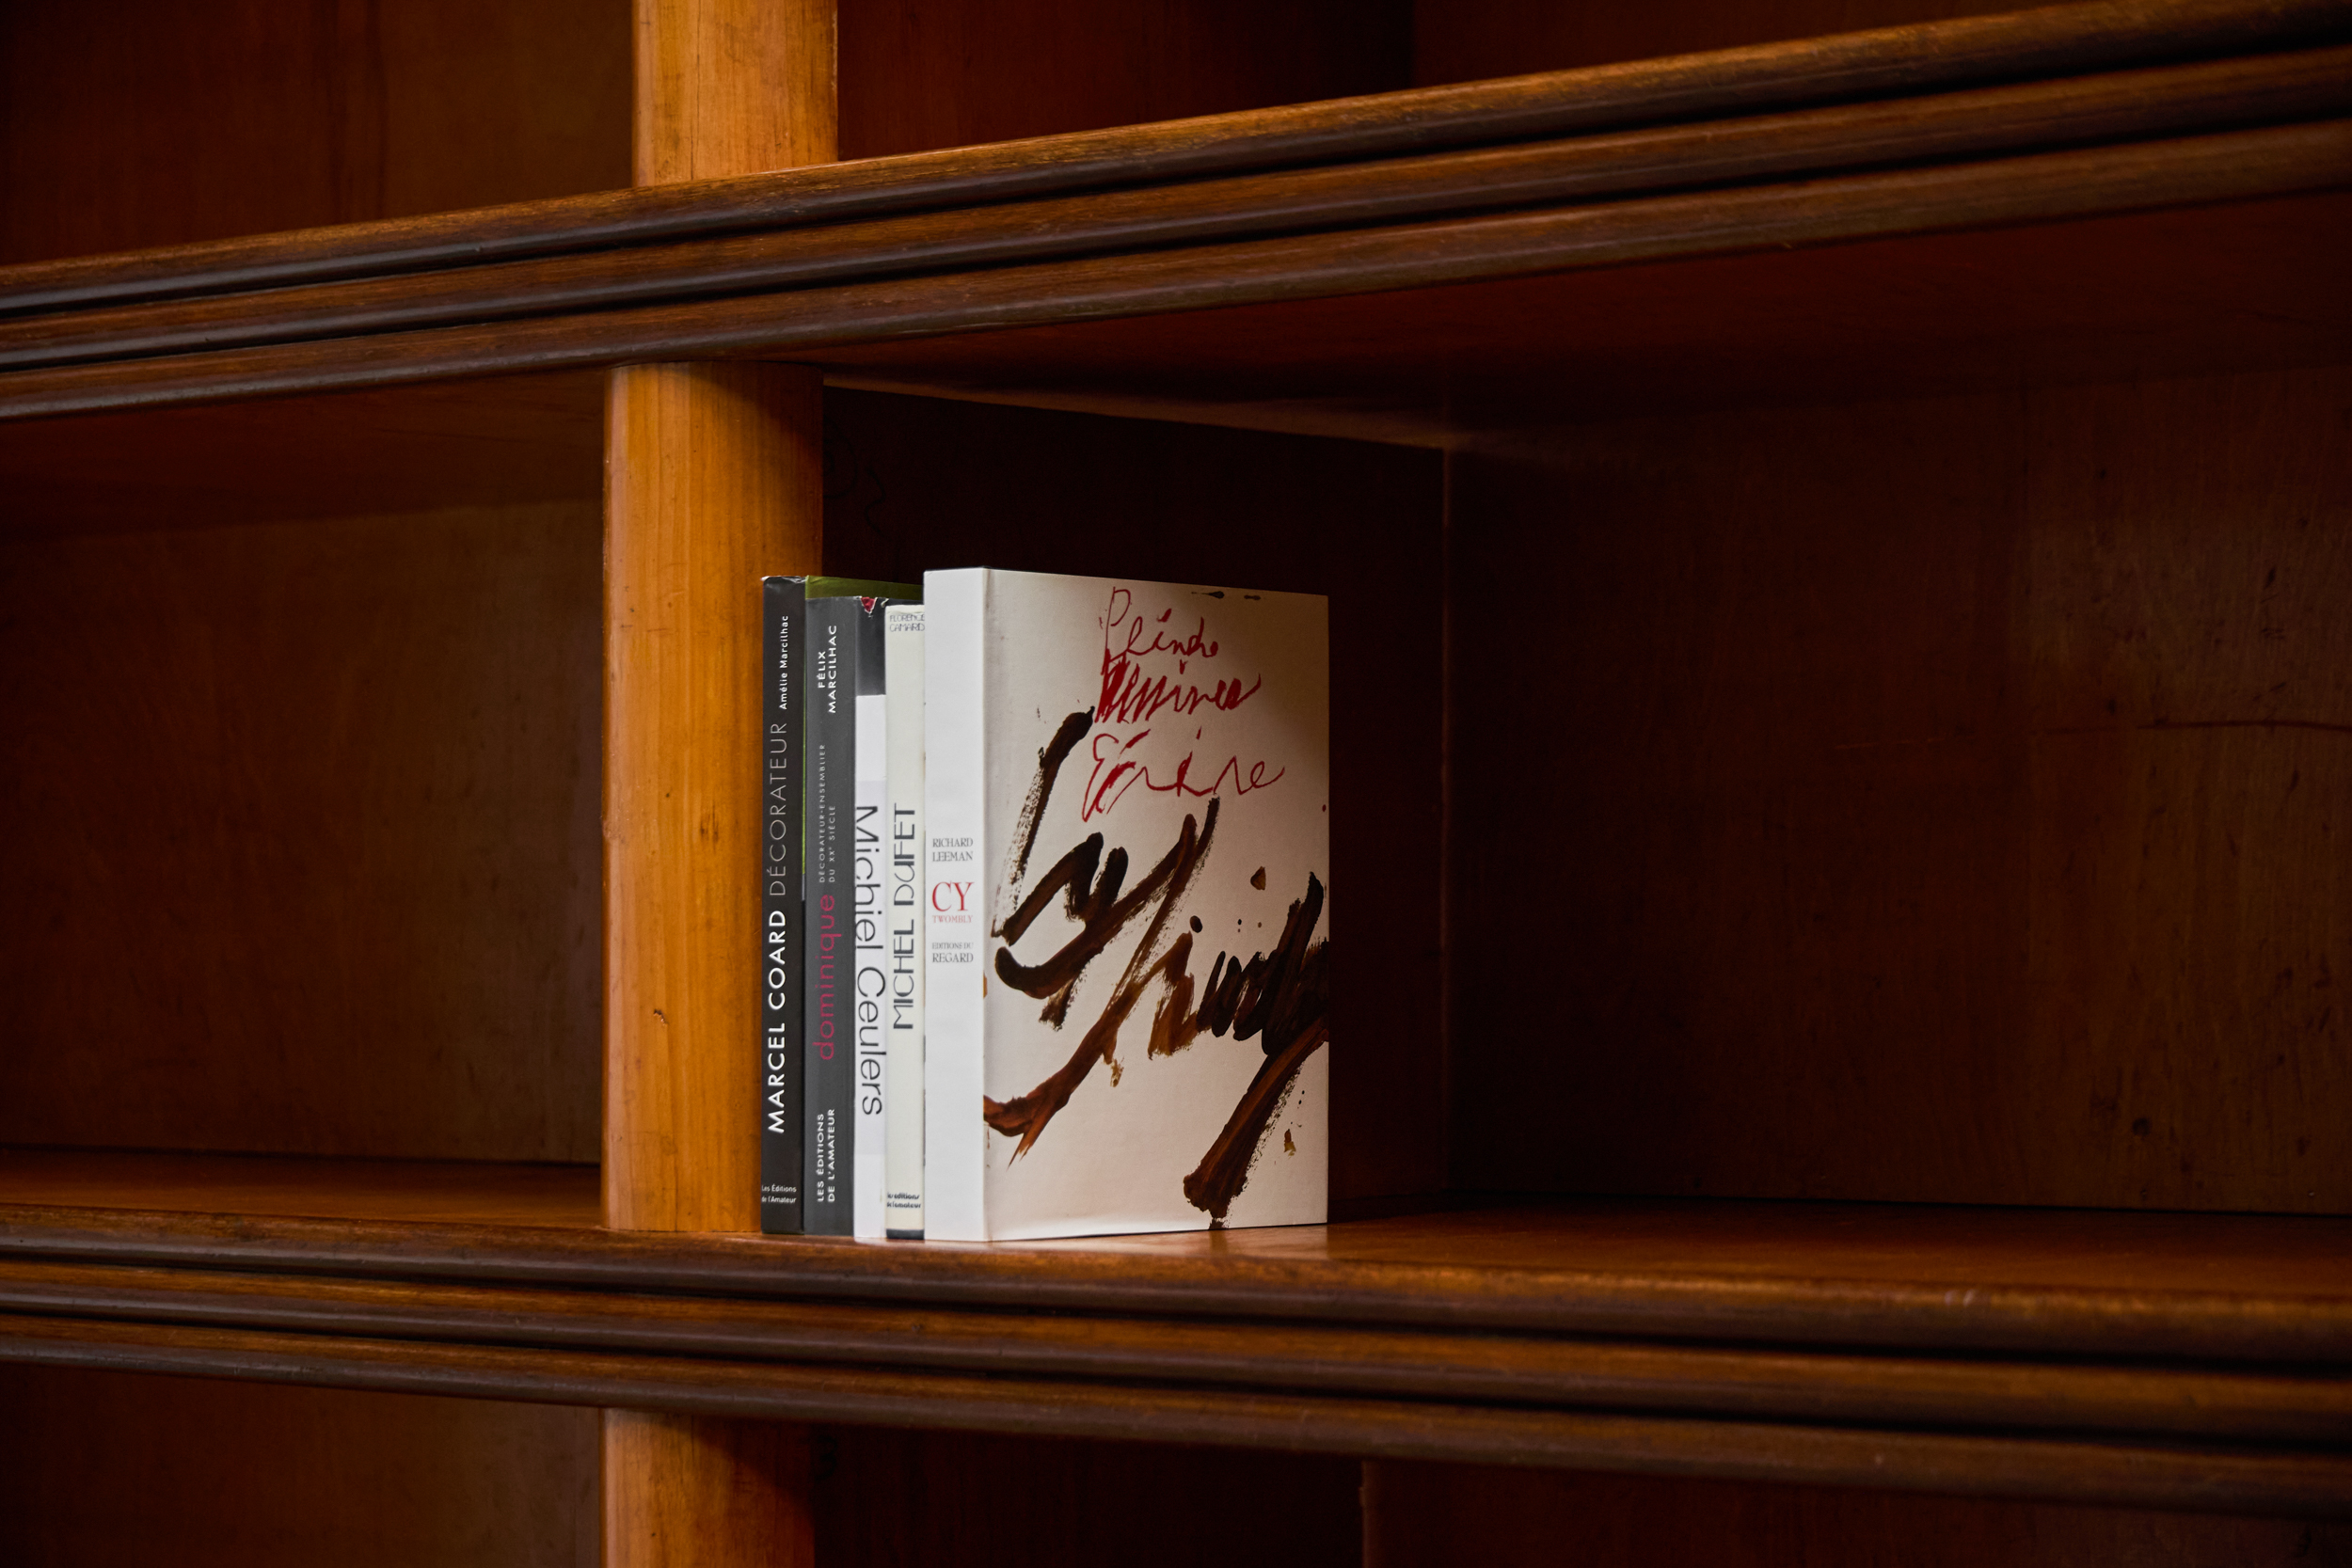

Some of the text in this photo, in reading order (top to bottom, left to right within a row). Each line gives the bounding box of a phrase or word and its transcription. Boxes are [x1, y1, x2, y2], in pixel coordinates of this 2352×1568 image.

[889, 623, 926, 632] CAMARD
[779, 615, 788, 710] Amélie Marcilhac
[817, 651, 826, 689] FÉLIX
[828, 625, 837, 713] MARCILHAC
[932, 838, 974, 847] RICHARD
[932, 851, 974, 862] LEEMAN
[828, 869, 835, 883] DU
[931, 880, 975, 912] CY
[767, 722, 787, 1134] MARCEL COARD DÉCORATEUR
[893, 802, 915, 1030] MICHEL DUFET
[932, 915, 974, 924] TWOMBLY
[855, 805, 887, 1116] Michiel Ceulers
[932, 953, 974, 963] REGARD
[812, 895, 842, 1060] dominique
[816, 1114, 825, 1203] LES ÉDITIONS
[827, 1109, 835, 1203] DE L'AMATEUR
[771, 1182, 798, 1193] Éditions
